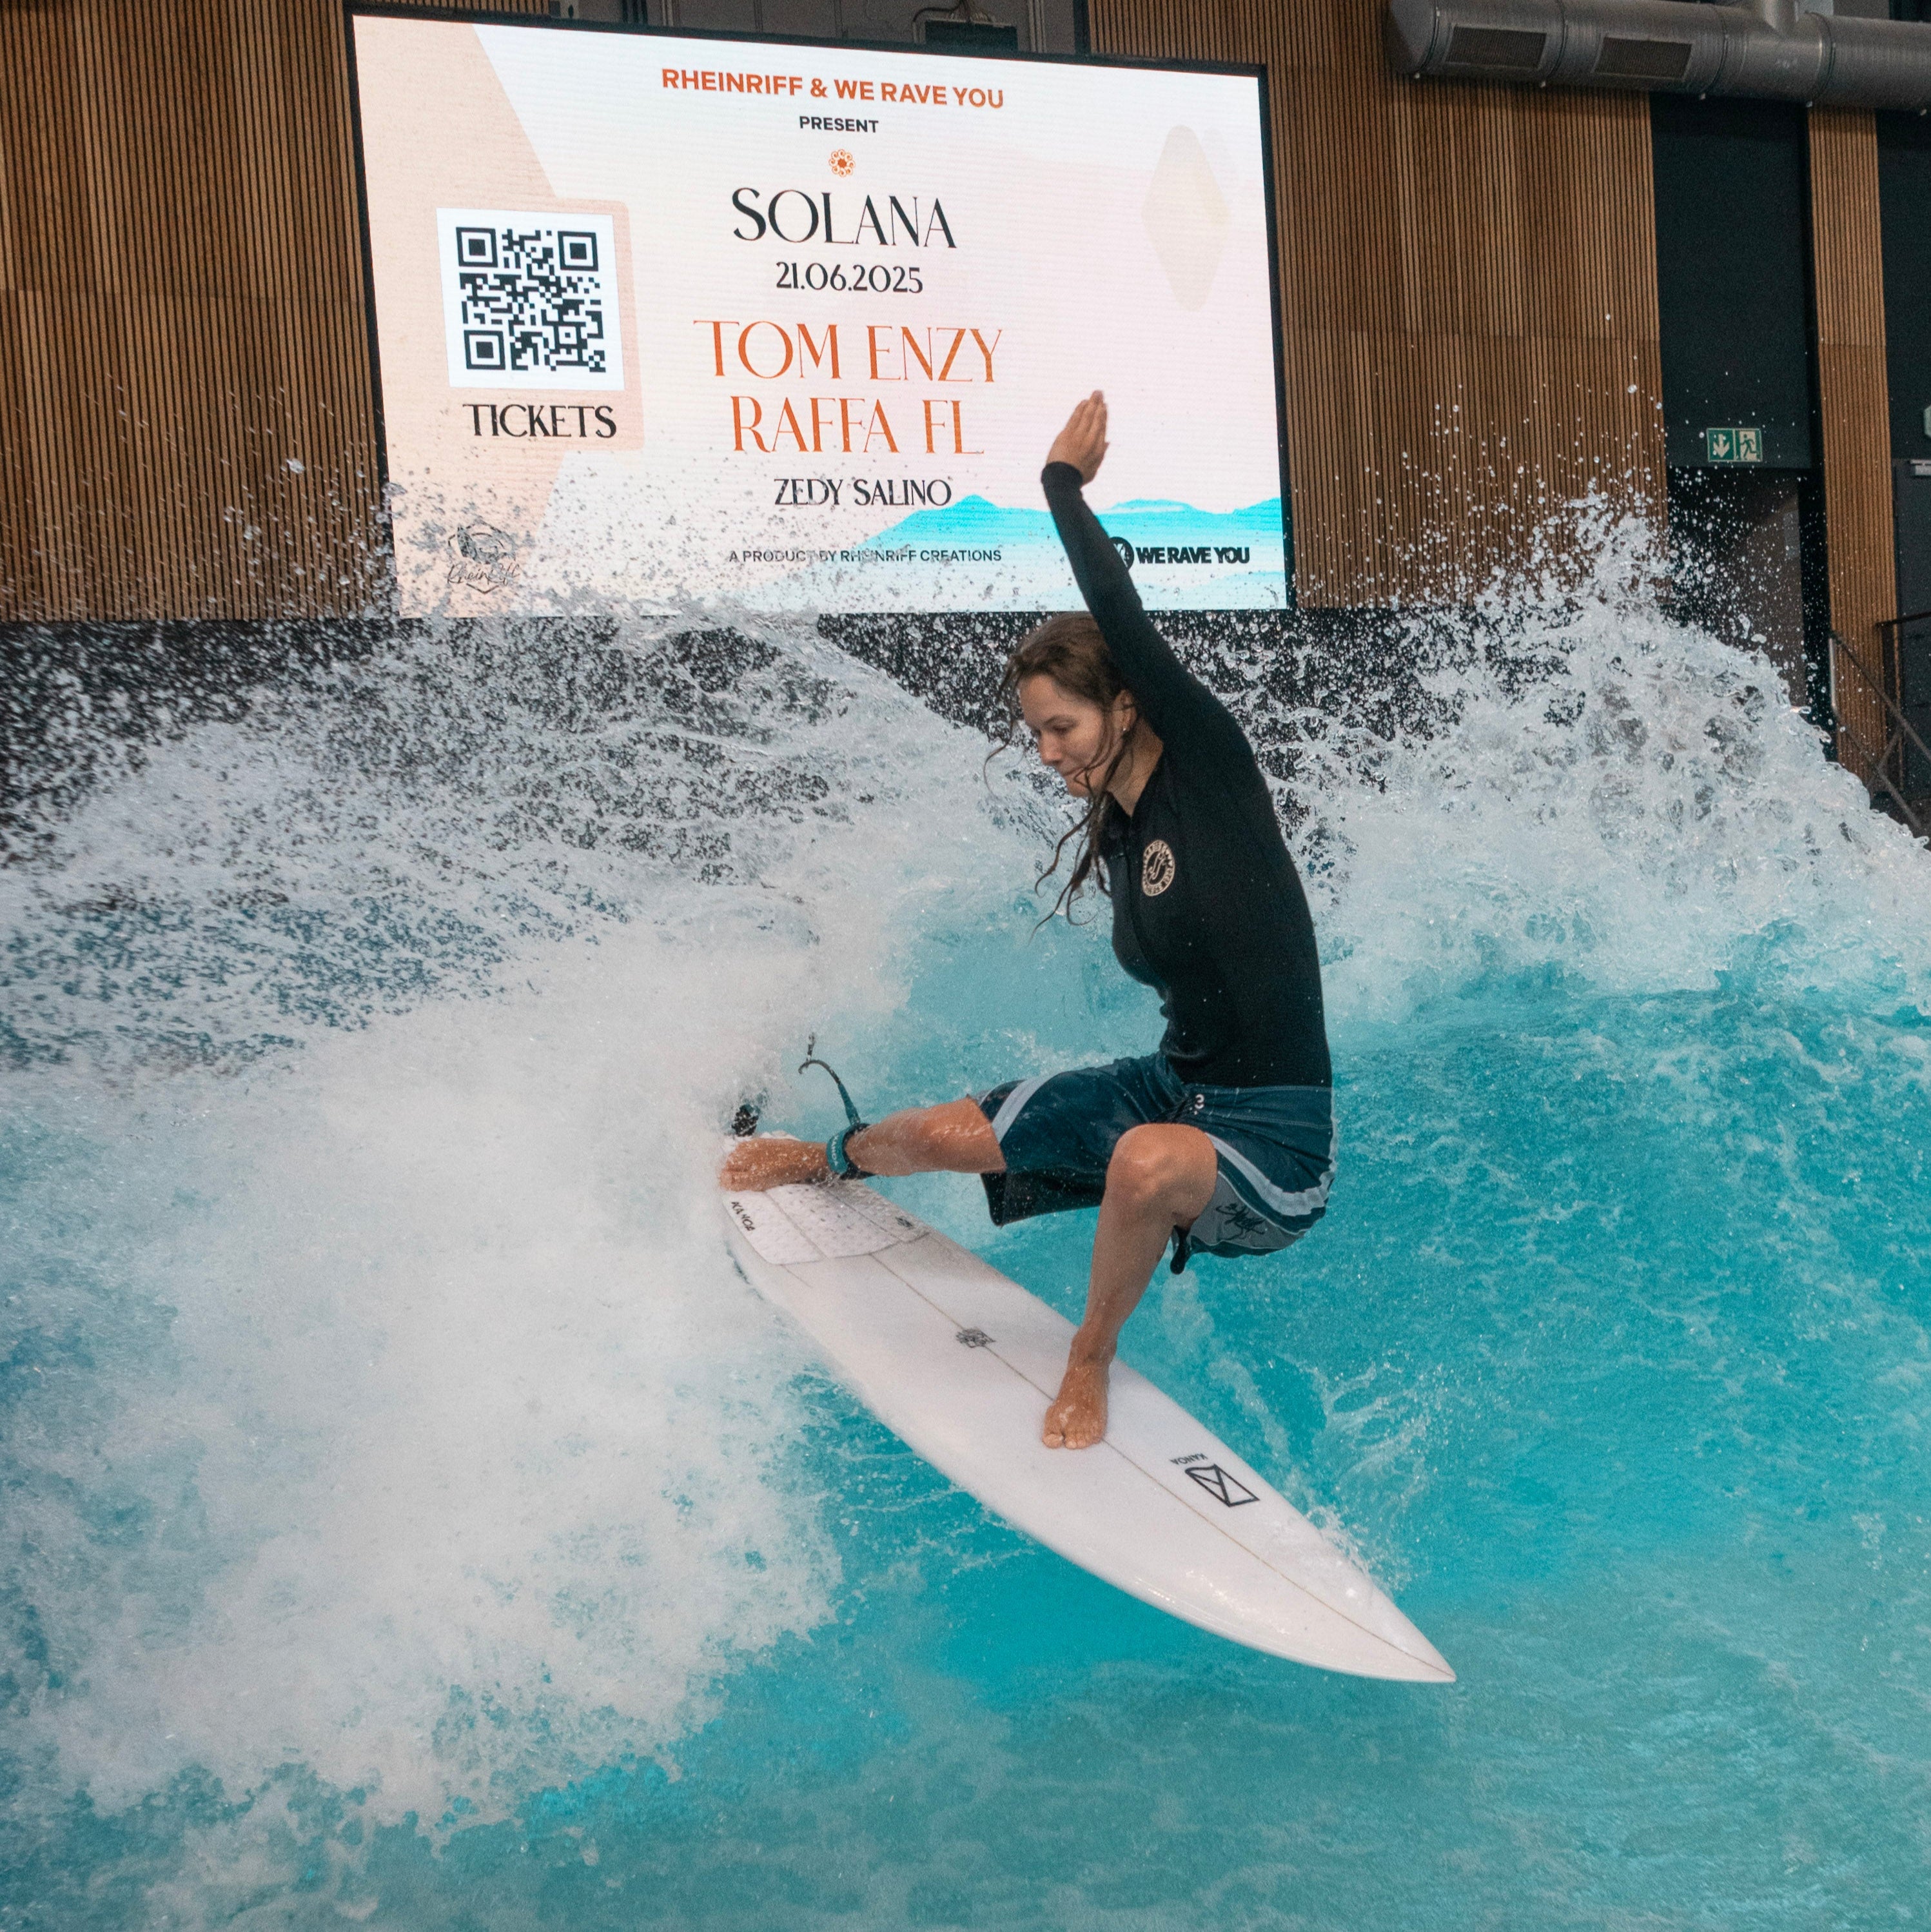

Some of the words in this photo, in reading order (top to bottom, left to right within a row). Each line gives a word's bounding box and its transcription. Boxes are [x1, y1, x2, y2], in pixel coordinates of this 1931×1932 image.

[662, 68, 803, 95] RHEINRIFF
[809, 78, 828, 97] &
[834, 79, 875, 101] WE
[881, 82, 948, 105] RAVE
[953, 86, 1005, 108] YOU
[799, 115, 879, 133] PRESENT
[731, 187, 957, 249] SOLANA
[776, 261, 923, 293] 21.06.2025
[693, 320, 842, 380] TOM
[867, 325, 1003, 382] ENZY
[462, 404, 617, 439] TICKETS
[730, 395, 900, 453] RAFFA
[922, 399, 985, 455] FL
[774, 478, 843, 506] ZEDY
[853, 478, 952, 506] SALINO
[729, 550, 740, 562] A
[819, 550, 838, 562] BY
[840, 549, 917, 562] RHNRIFF
[920, 549, 1002, 562] CREATIONS
[1135, 546, 1166, 564] WE
[1168, 546, 1212, 564] RAVE
[1213, 546, 1250, 564] YOU
[730, 1201, 756, 1231] KANOA
[1169, 1452, 1208, 1465] KANOA
